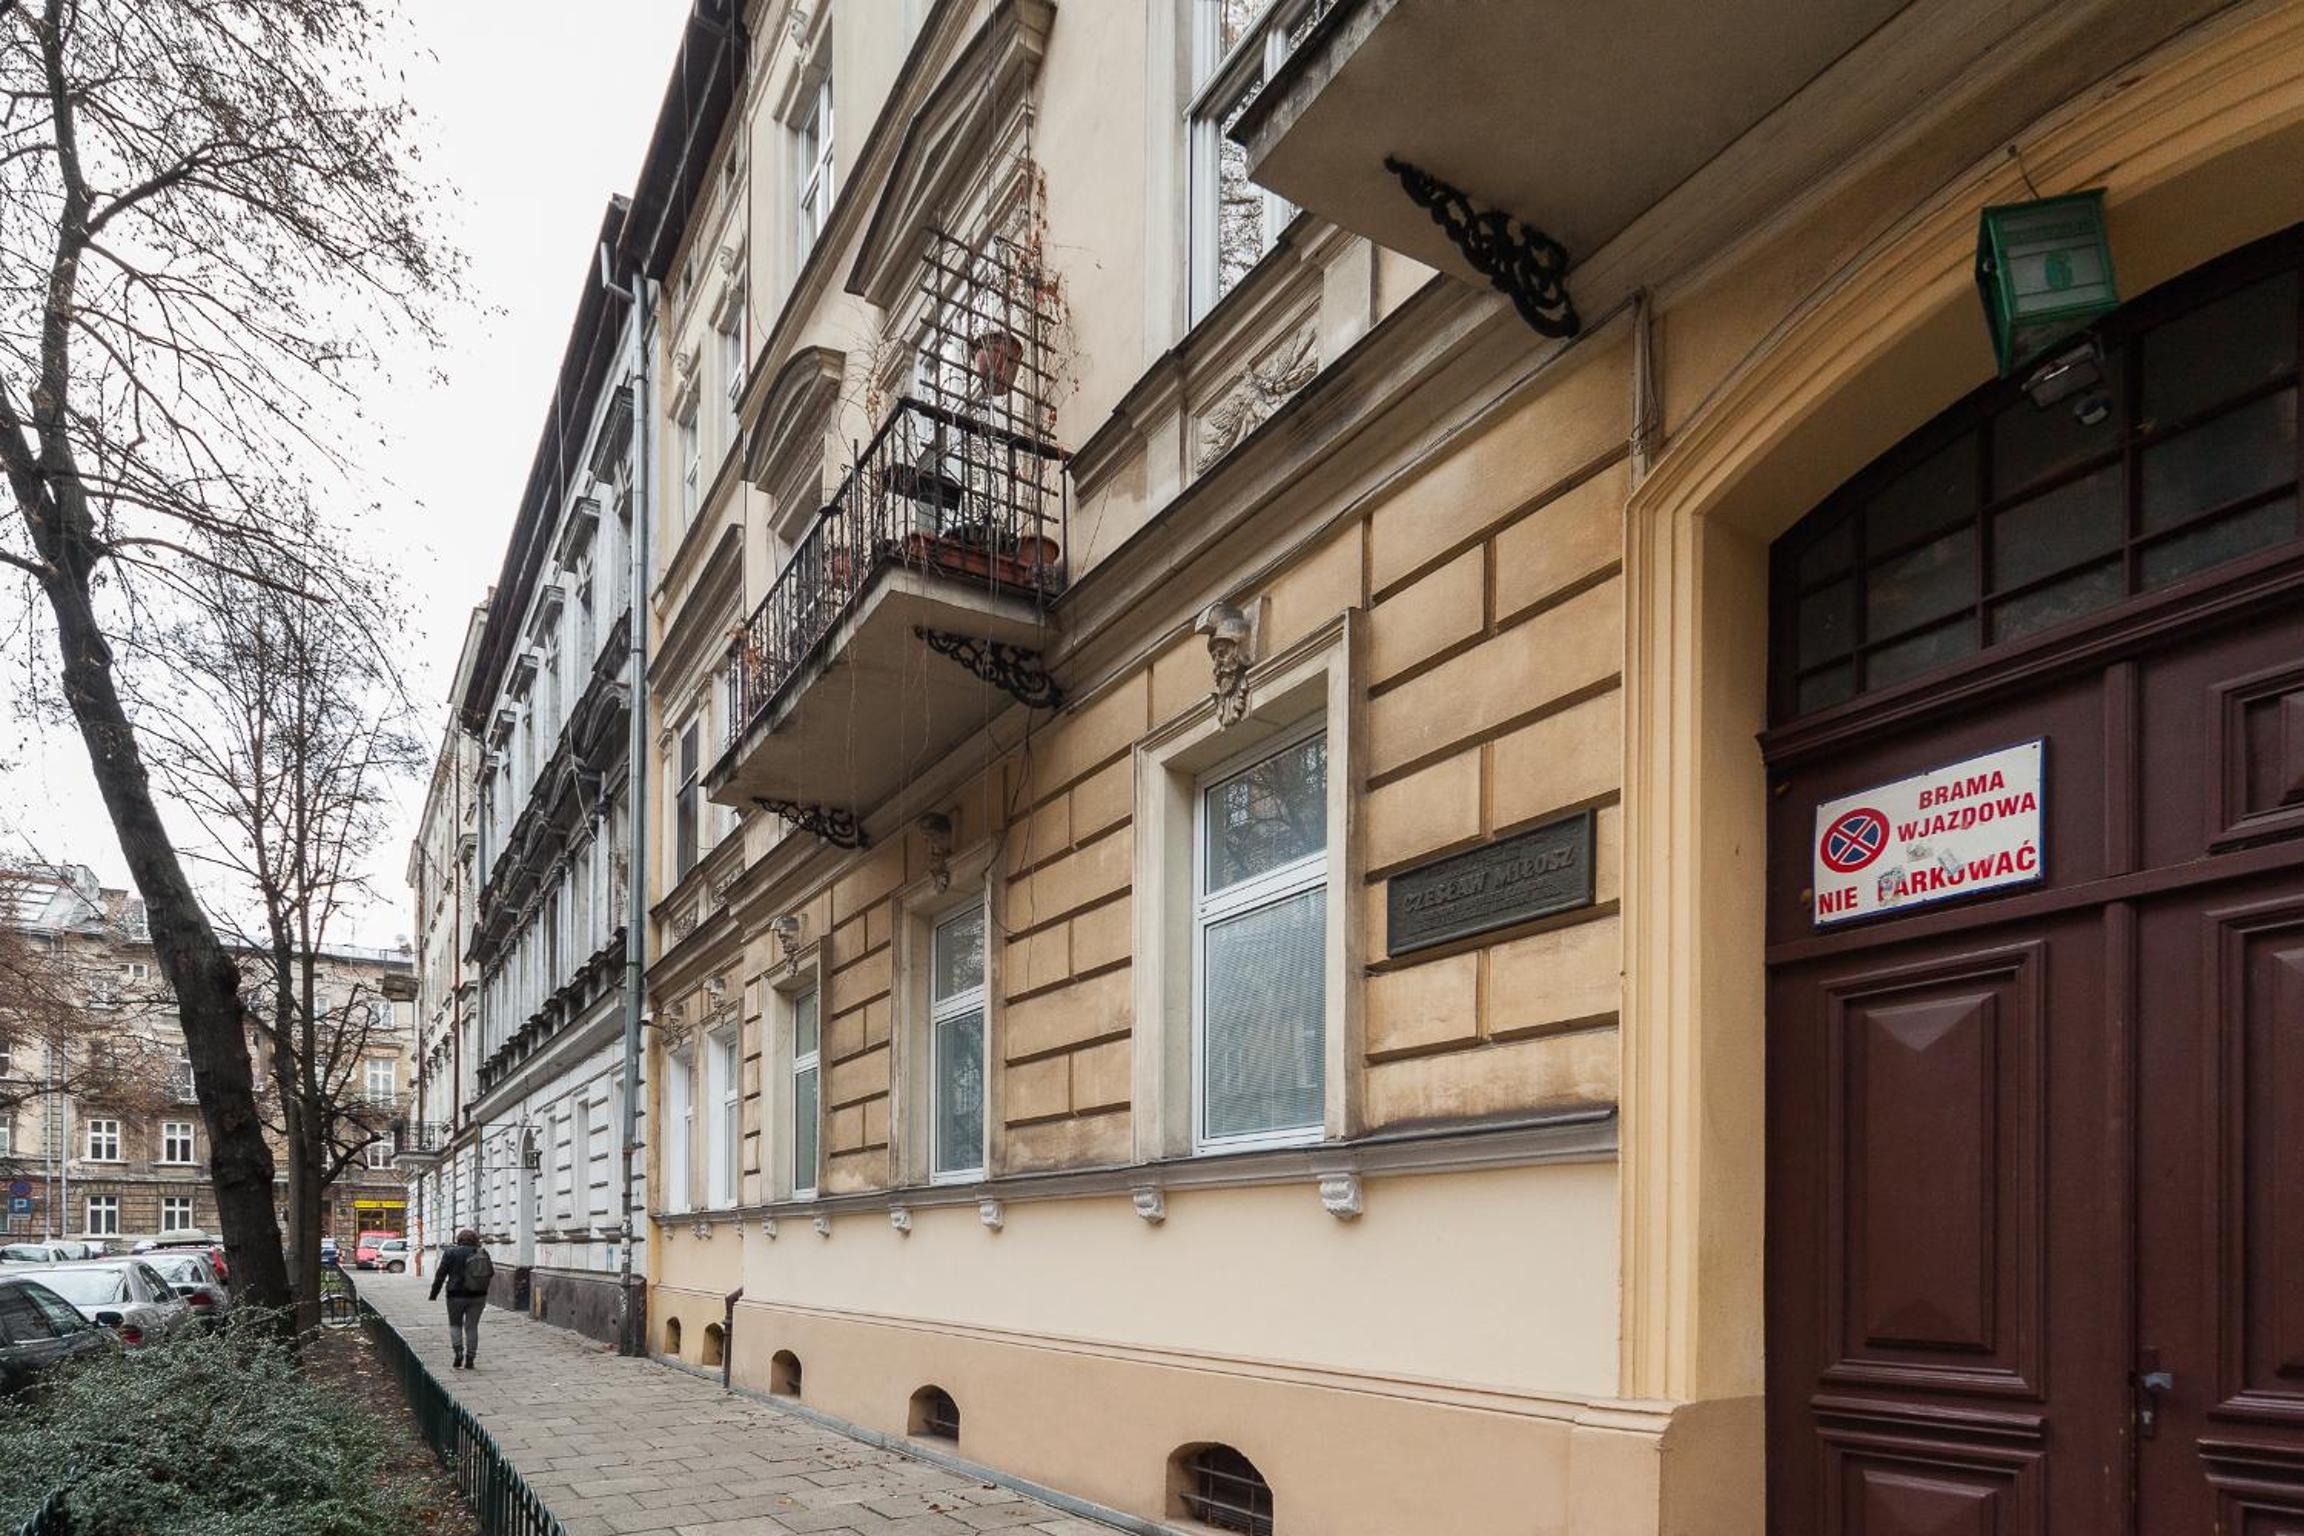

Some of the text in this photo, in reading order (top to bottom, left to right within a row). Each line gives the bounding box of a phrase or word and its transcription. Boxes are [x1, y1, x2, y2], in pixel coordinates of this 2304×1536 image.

[1919, 771, 2004, 809] BRAMA
[1897, 792, 2036, 842] WJAZDOWA
[1819, 886, 1858, 914] NIE
